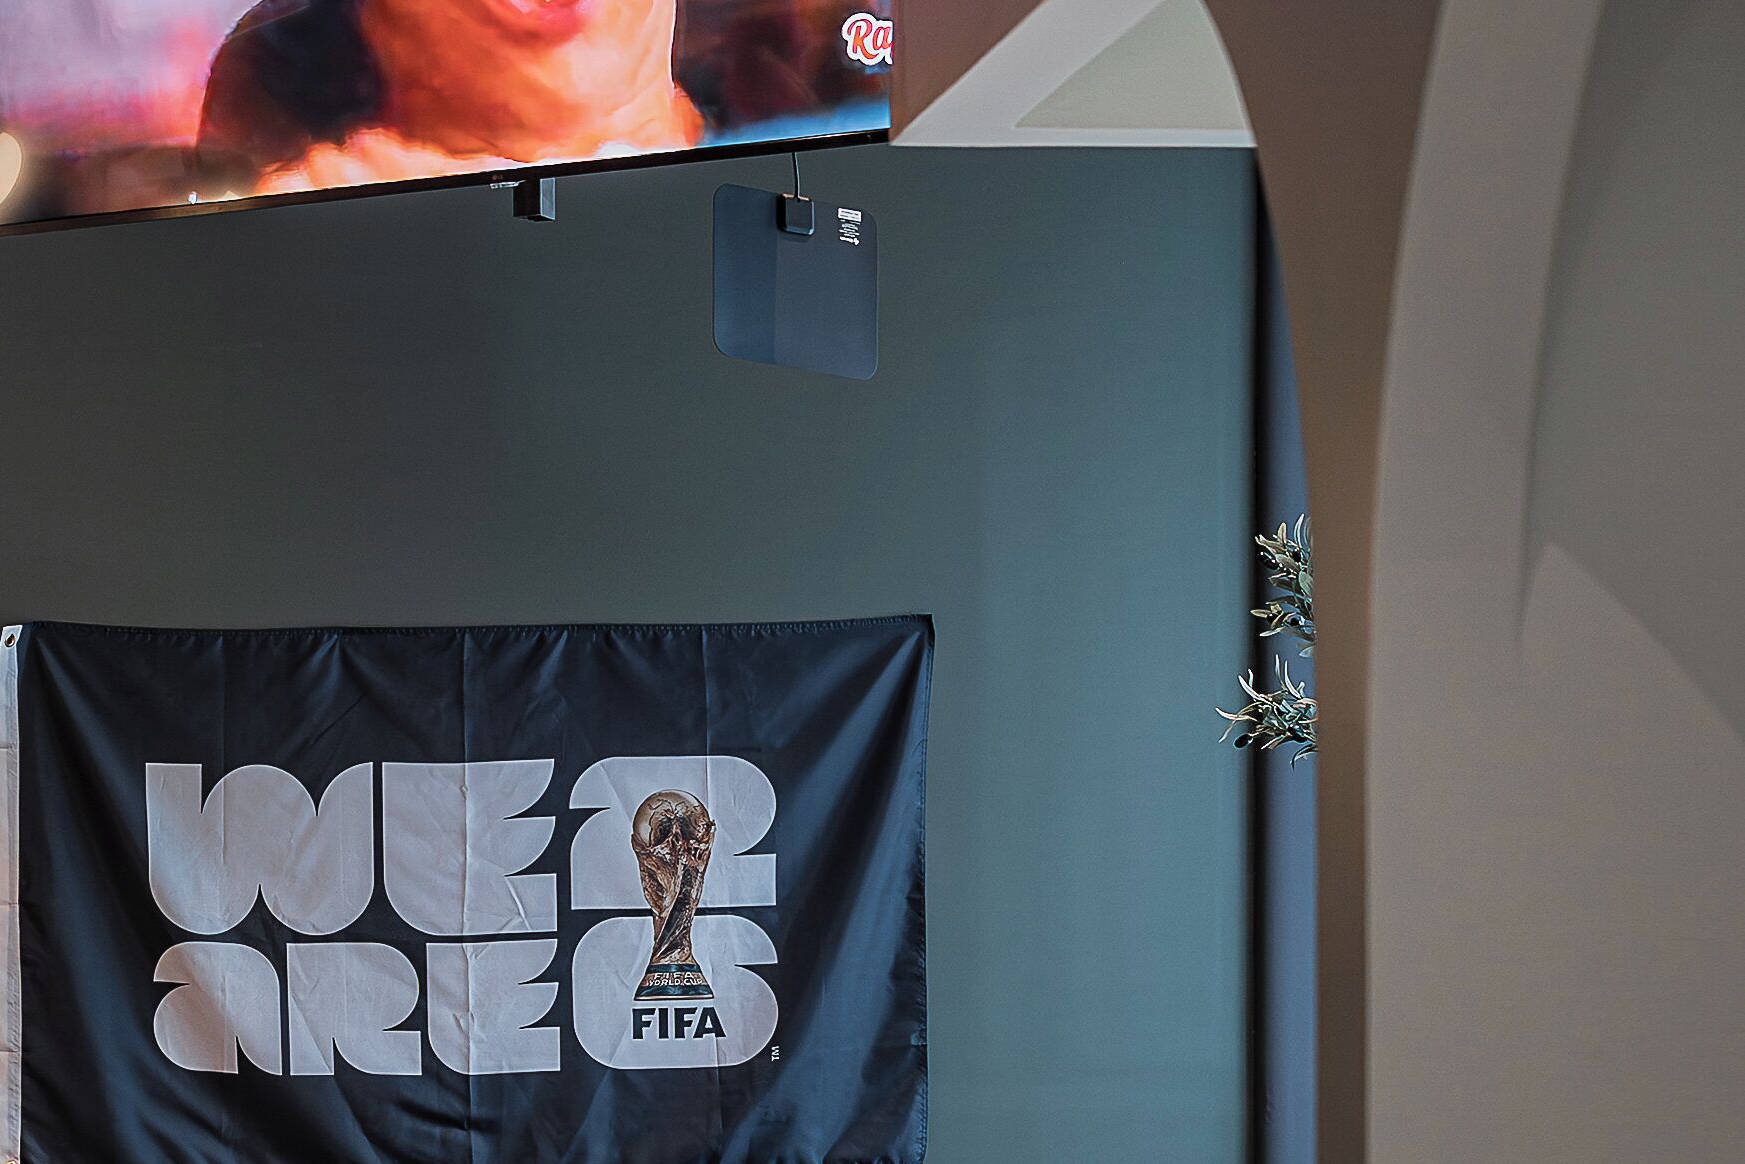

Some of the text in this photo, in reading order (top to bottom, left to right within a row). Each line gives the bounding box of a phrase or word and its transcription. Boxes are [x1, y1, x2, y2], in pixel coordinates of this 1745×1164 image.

[845, 15, 894, 61] Ra
[146, 759, 557, 935] WE
[653, 972, 695, 980] FIFA
[153, 939, 561, 1076] ARE
[632, 1006, 727, 1040] FIFA
